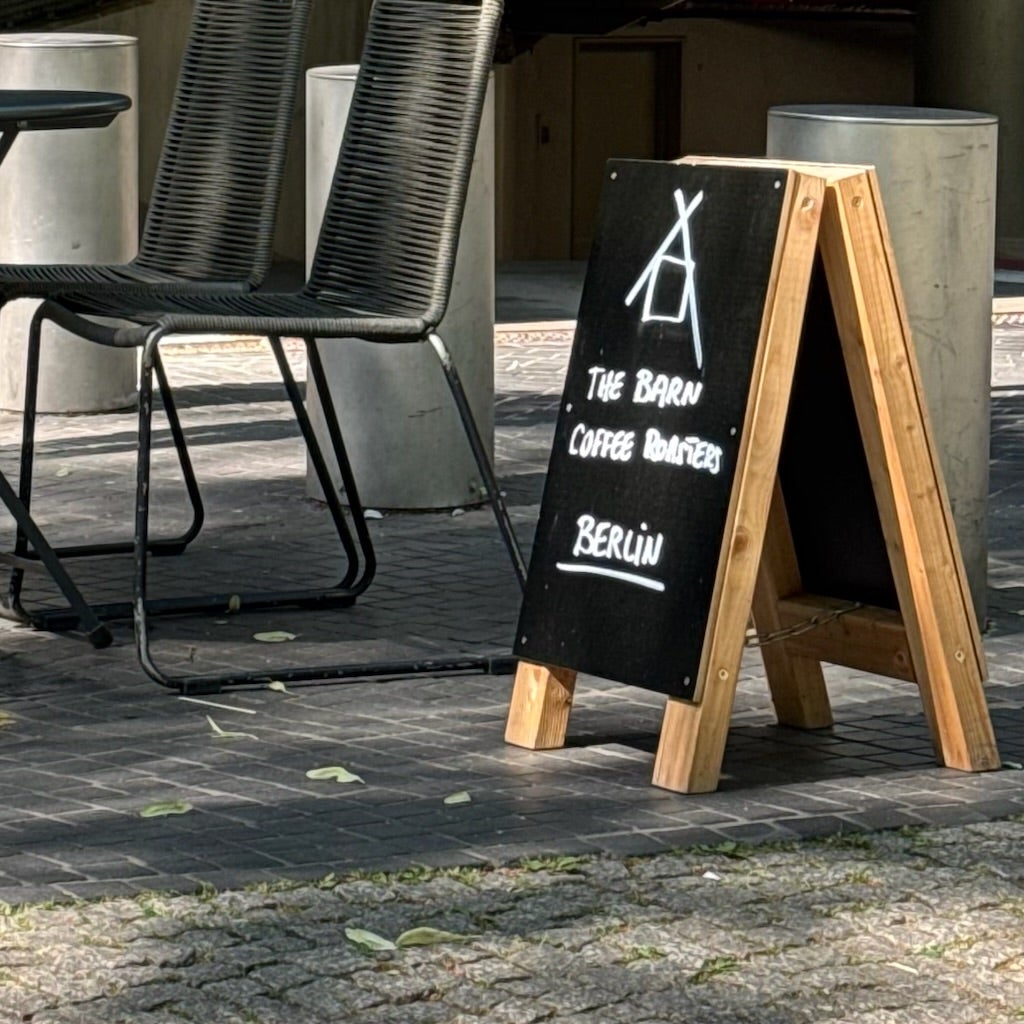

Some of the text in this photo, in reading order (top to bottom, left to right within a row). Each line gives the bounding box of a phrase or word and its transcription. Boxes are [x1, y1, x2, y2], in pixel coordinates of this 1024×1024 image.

[586, 365, 704, 409] THE BARN
[568, 422, 724, 475] COFFEE ROASTERS
